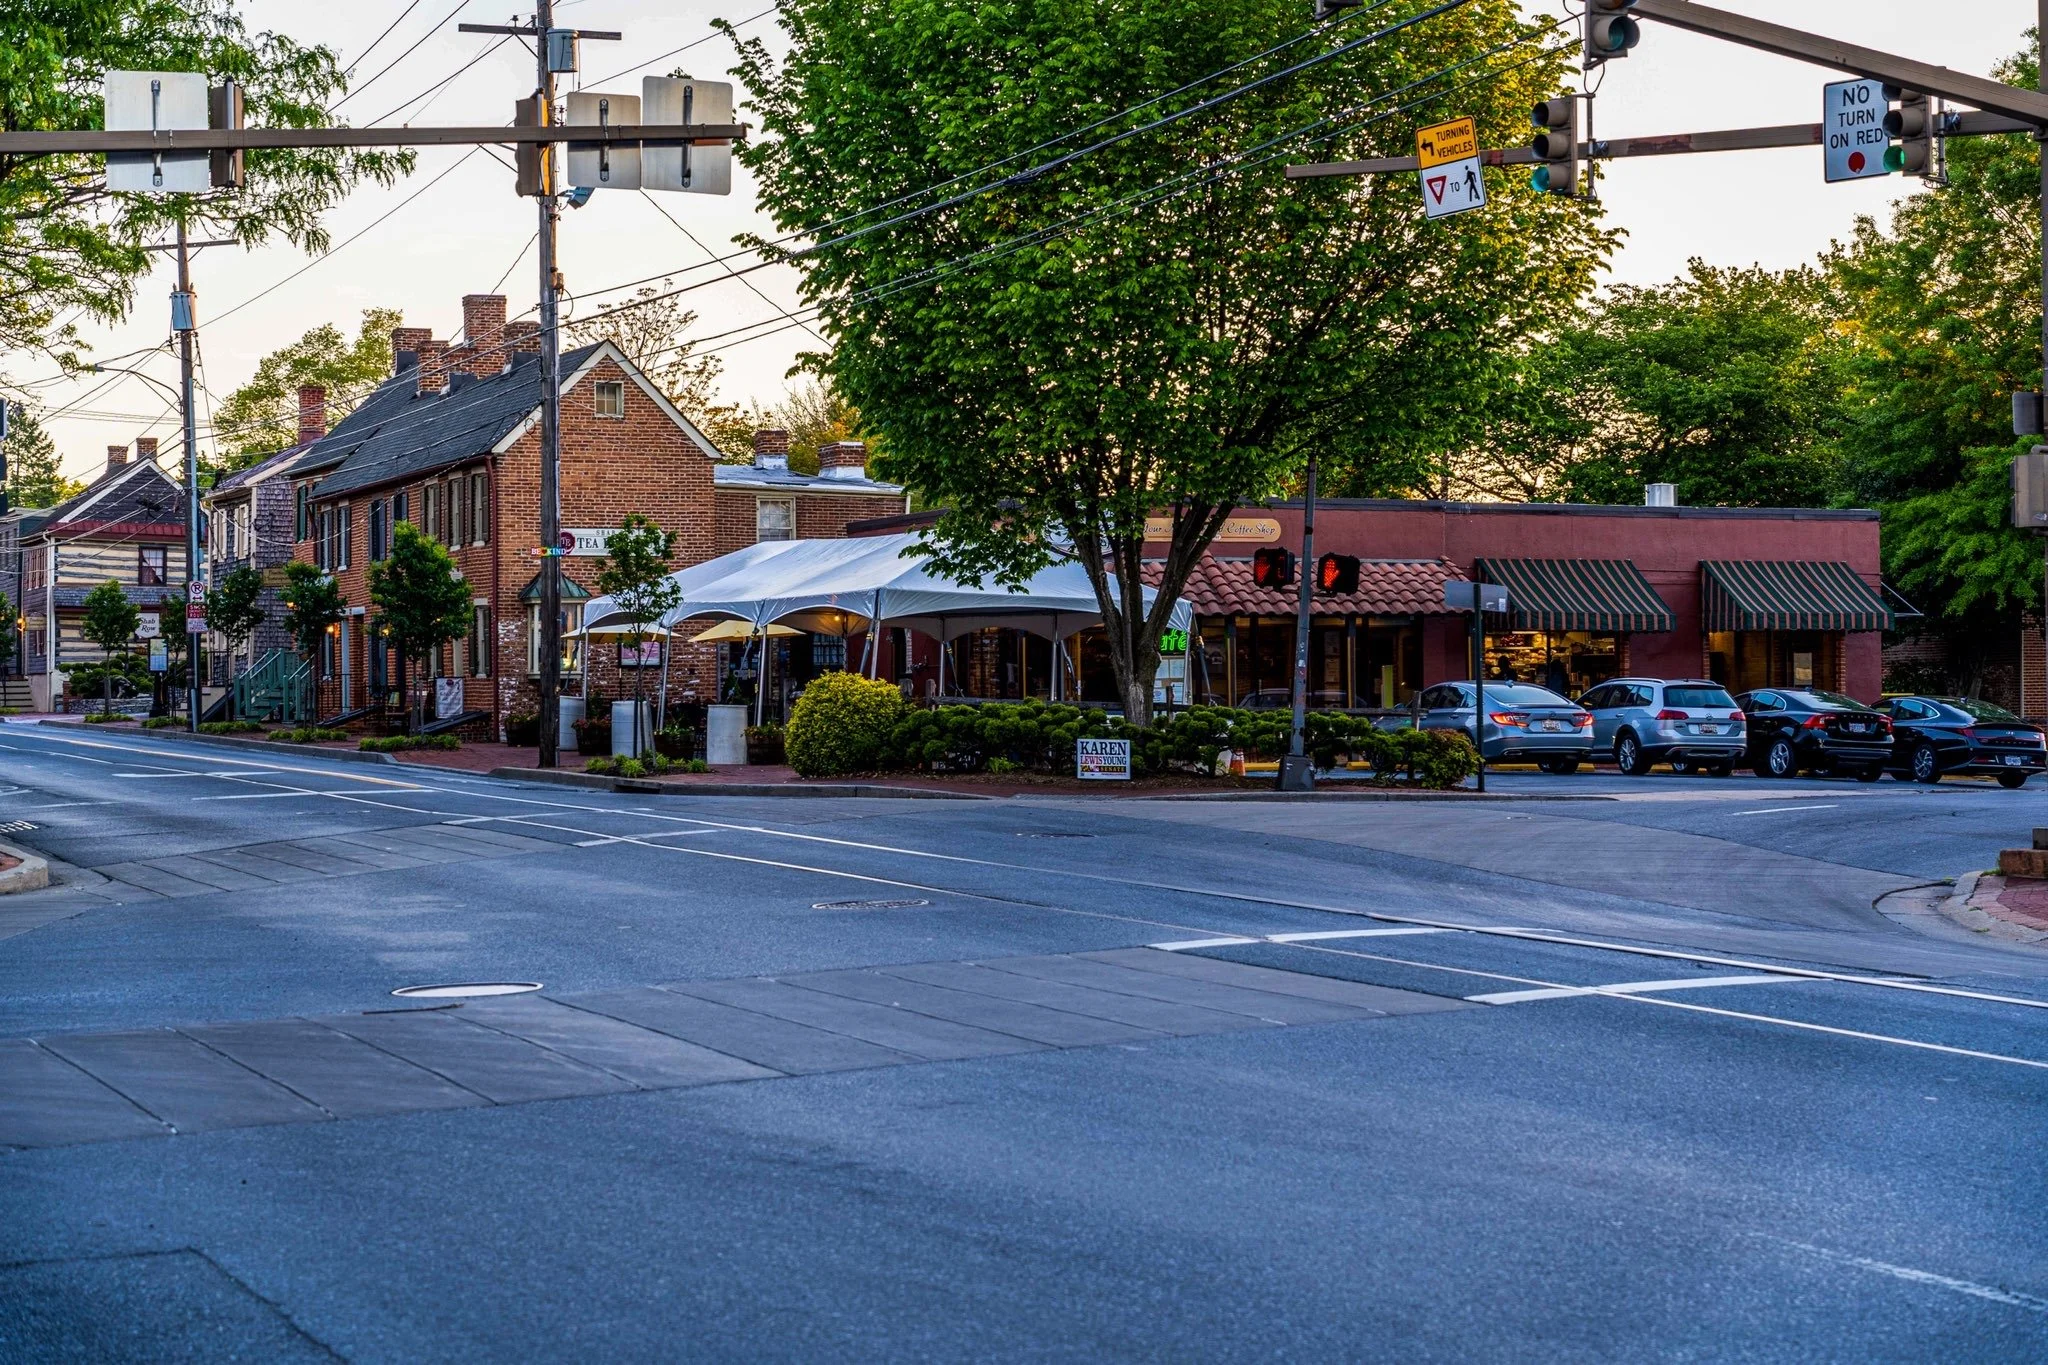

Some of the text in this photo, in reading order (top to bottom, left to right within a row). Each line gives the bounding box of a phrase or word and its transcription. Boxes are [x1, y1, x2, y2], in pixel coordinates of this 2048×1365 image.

[1842, 85, 1870, 107] NO
[1838, 108, 1875, 127] TURN
[1435, 124, 1470, 142] TURNING
[1830, 127, 1883, 149] ON RED
[1436, 140, 1474, 159] VEHICLES
[1449, 181, 1460, 193] TO
[1226, 521, 1254, 535] Coffee
[1255, 522, 1276, 536] Shop
[576, 537, 599, 549] TEA
[531, 547, 541, 555] BE
[546, 547, 567, 555] KIND
[141, 624, 156, 633] Row
[1080, 741, 1127, 756] KAREN
